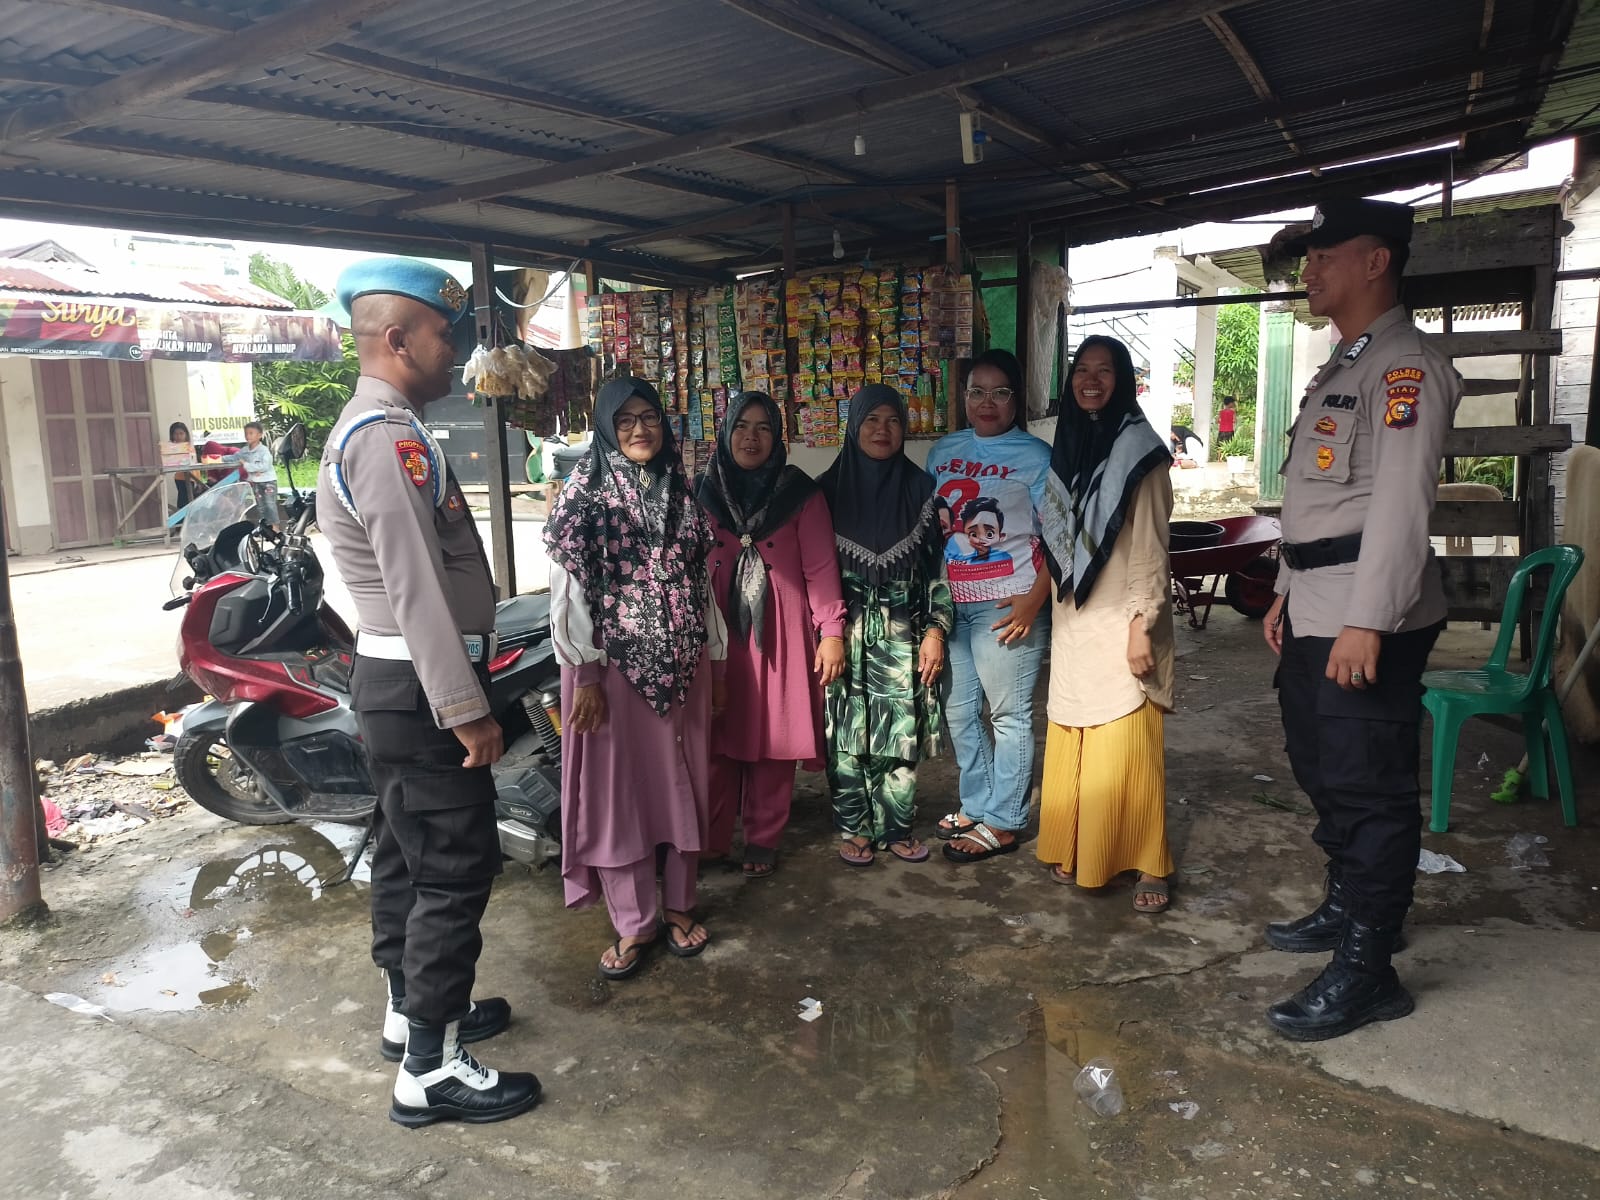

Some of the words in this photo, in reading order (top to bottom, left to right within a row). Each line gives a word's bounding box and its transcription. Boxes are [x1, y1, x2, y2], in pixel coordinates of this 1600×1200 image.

[42, 301, 136, 338] Surya
[187, 341, 213, 353] HIDUP
[232, 343, 273, 354] NYALAKAN
[274, 343, 297, 354] HIDUP
[1390, 387, 1416, 395] RIAU
[1321, 394, 1357, 410] POLRI
